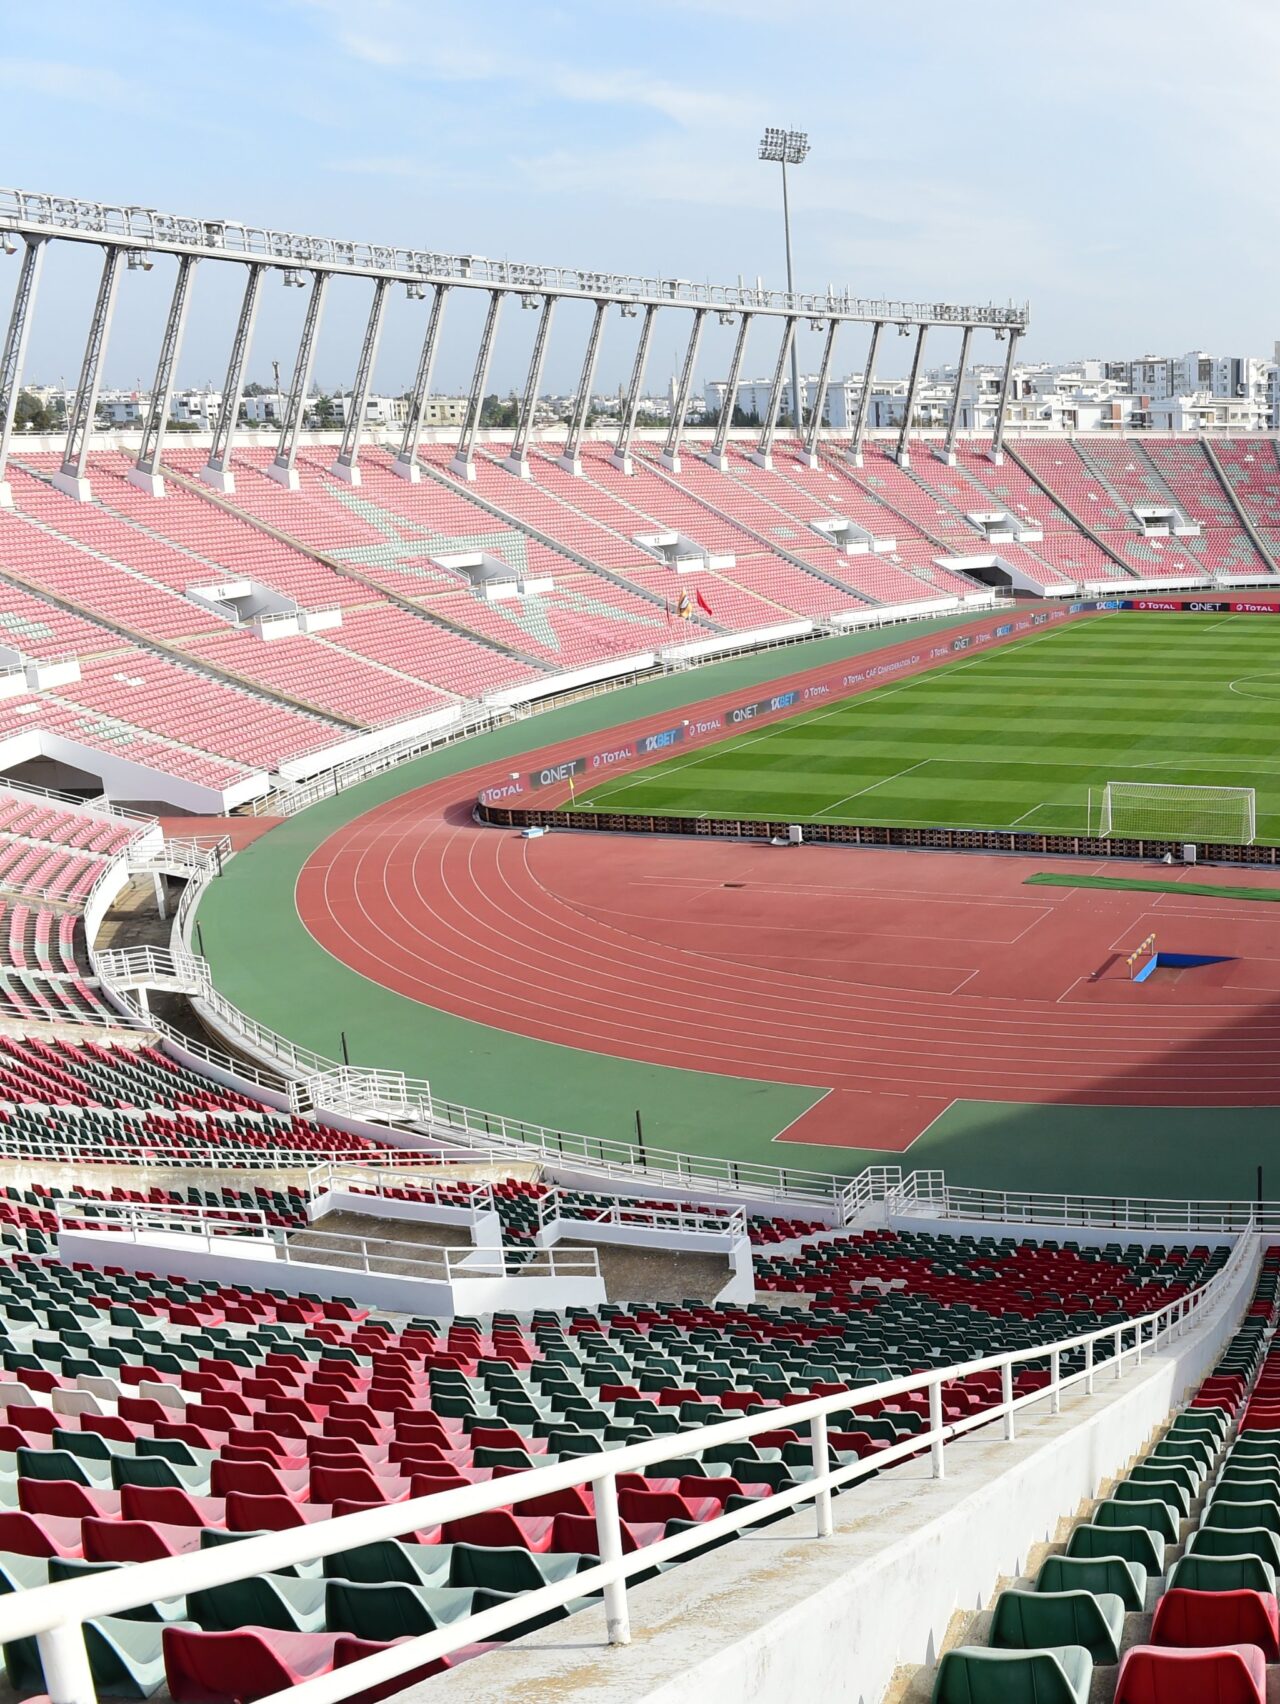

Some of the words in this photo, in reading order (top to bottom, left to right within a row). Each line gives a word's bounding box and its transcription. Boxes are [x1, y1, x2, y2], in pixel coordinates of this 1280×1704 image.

[1095, 601, 1124, 610] 1XBET
[1147, 602, 1176, 610] TOTAL
[1190, 603, 1222, 611] QNET
[809, 685, 829, 698] TOTAL
[771, 692, 795, 710] 1XBET
[733, 704, 758, 722] QNET
[697, 719, 721, 735] TOTAL
[645, 730, 676, 751] 1XBET
[602, 748, 631, 764] TOTAL
[540, 761, 576, 785] QNET
[486, 783, 523, 801] TOTAL
